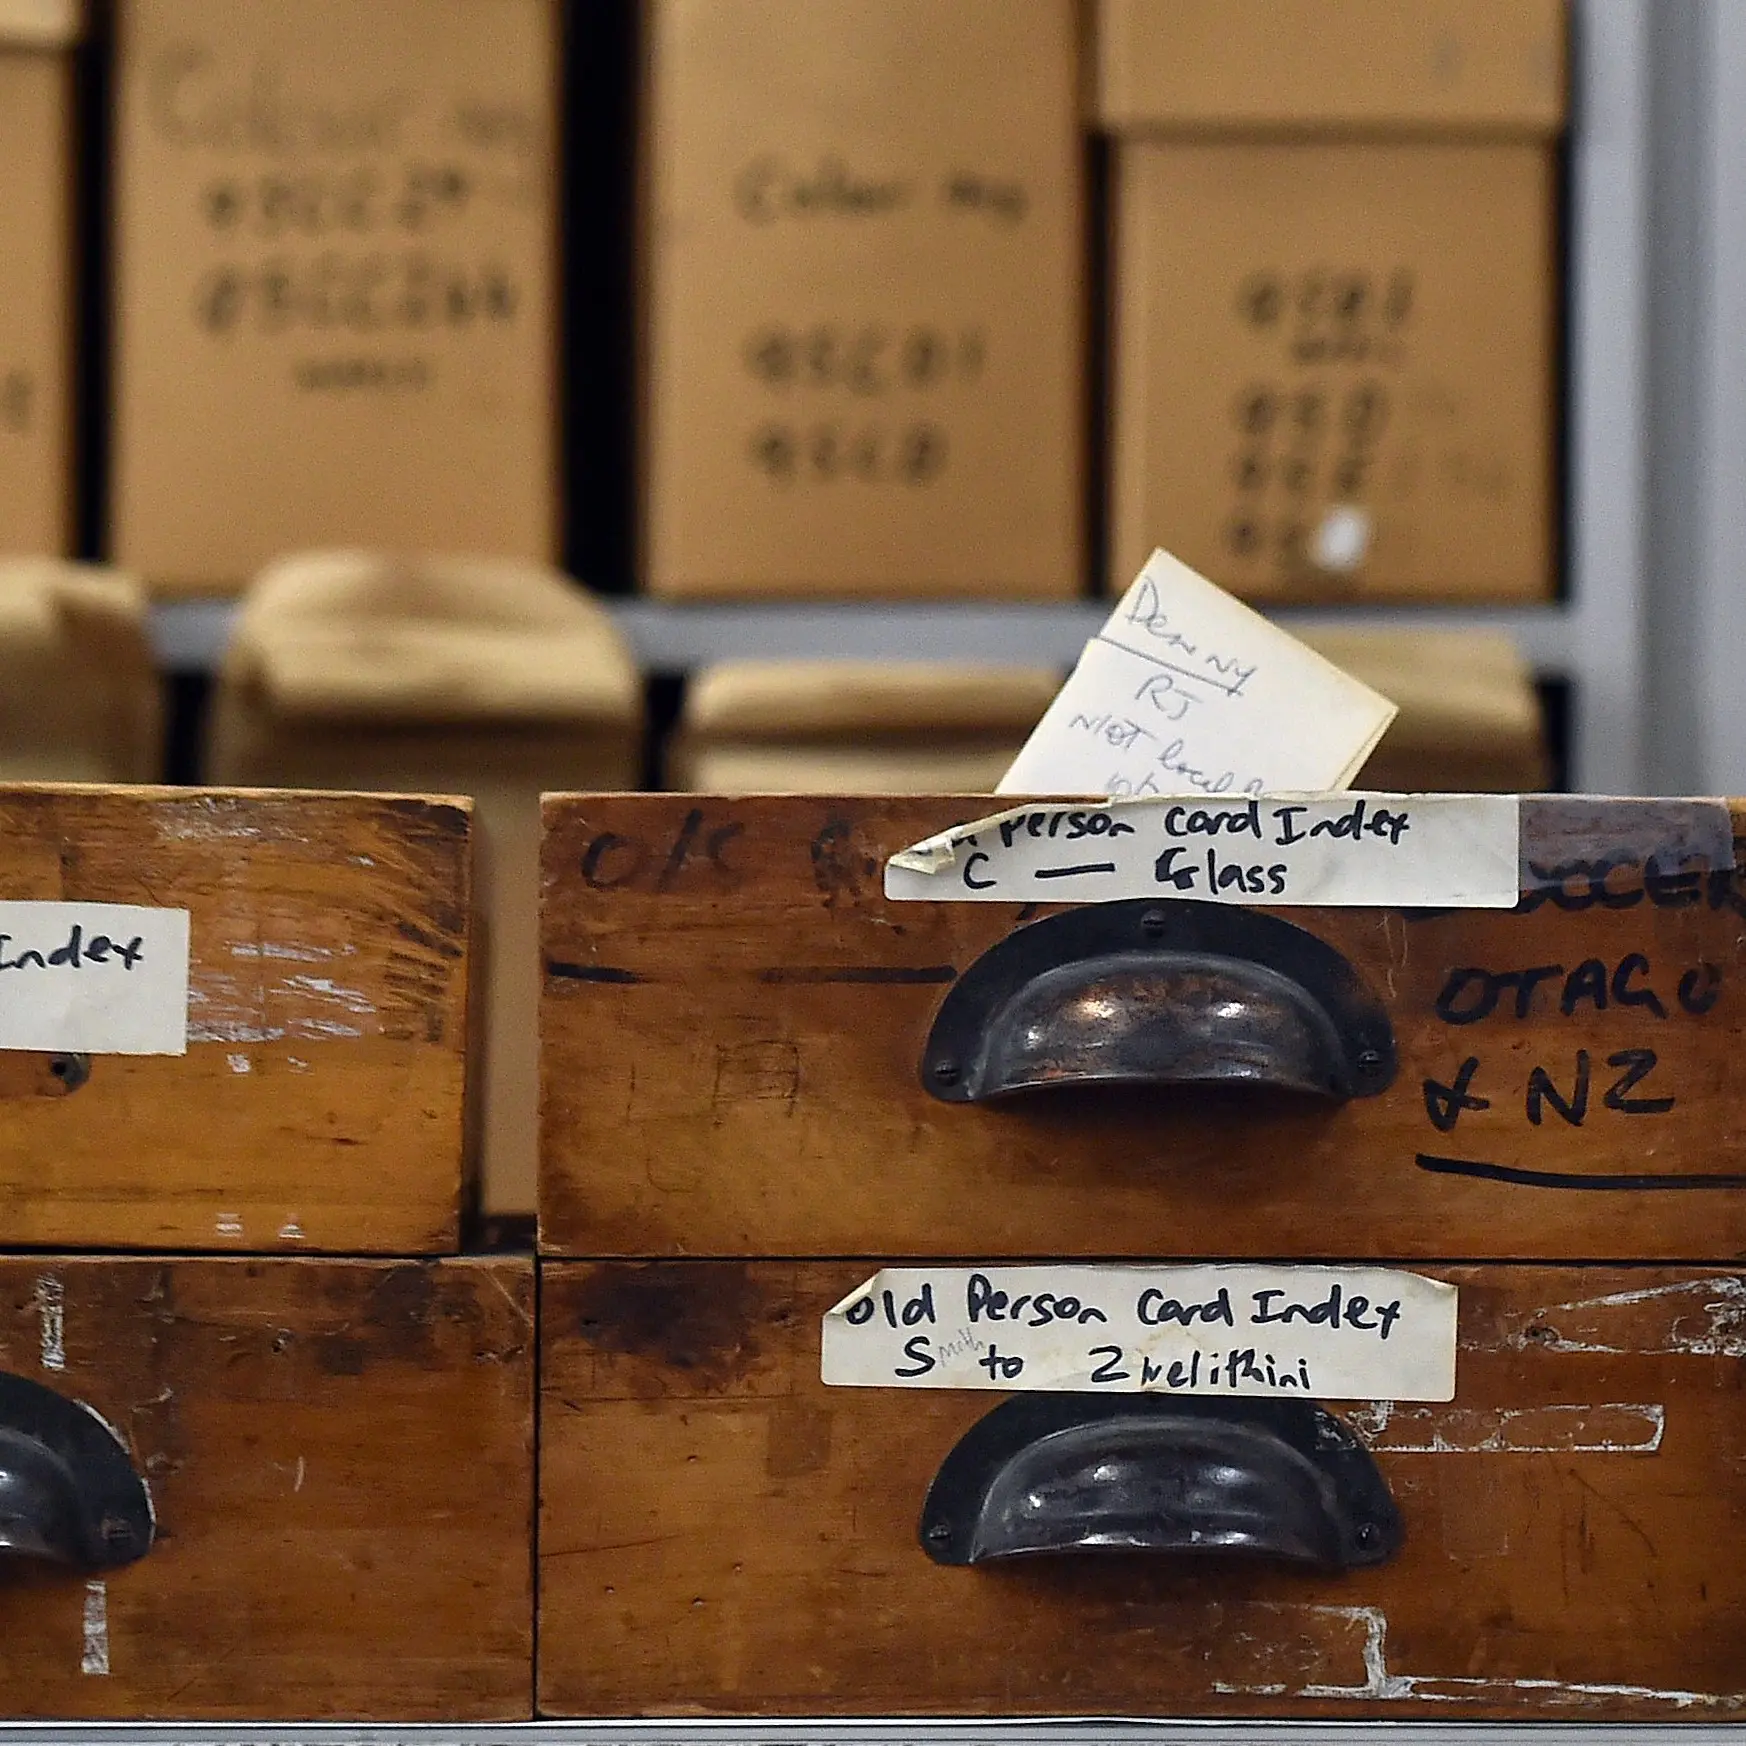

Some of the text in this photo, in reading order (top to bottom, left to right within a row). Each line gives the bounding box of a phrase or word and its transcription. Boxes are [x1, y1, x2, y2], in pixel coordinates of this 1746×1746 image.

[1273, 800, 1410, 845] Index
[1155, 847, 1287, 895] Glass
[1524, 1049, 1675, 1127] NZ
[967, 1273, 1107, 1327] Person
[1138, 1288, 1234, 1327] Card
[1250, 1284, 1401, 1340] Index
[979, 1344, 1024, 1380] to
